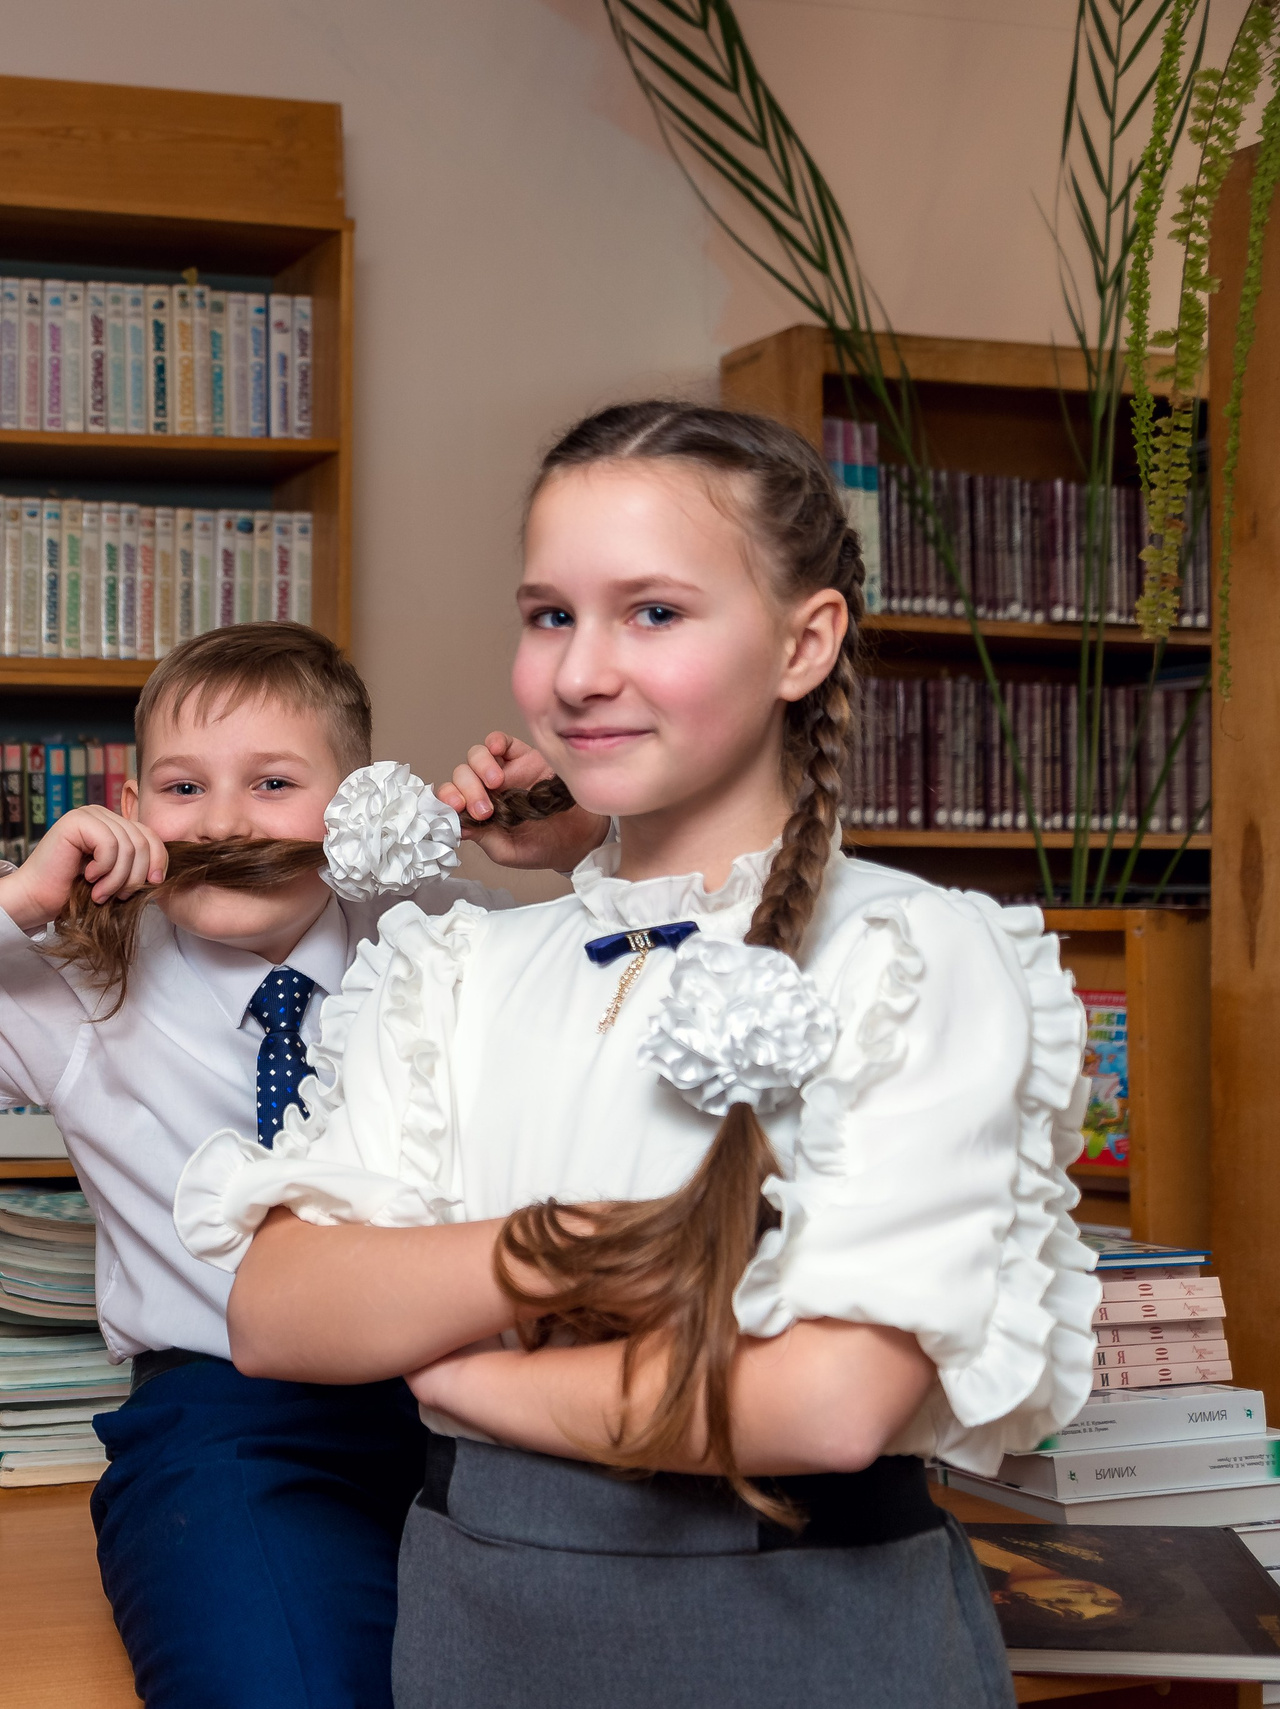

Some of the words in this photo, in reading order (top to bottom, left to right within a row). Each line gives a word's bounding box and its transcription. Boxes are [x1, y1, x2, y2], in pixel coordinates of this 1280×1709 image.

[1138, 1283, 1154, 1297] 10
[1141, 1304, 1158, 1318] 10
[1149, 1326, 1164, 1340] 10
[1155, 1347, 1169, 1362] 10
[1158, 1368, 1172, 1383] 10
[1187, 1409, 1228, 1424] ХИМИЯ
[1095, 1466, 1137, 1480] ХИМИЯ
